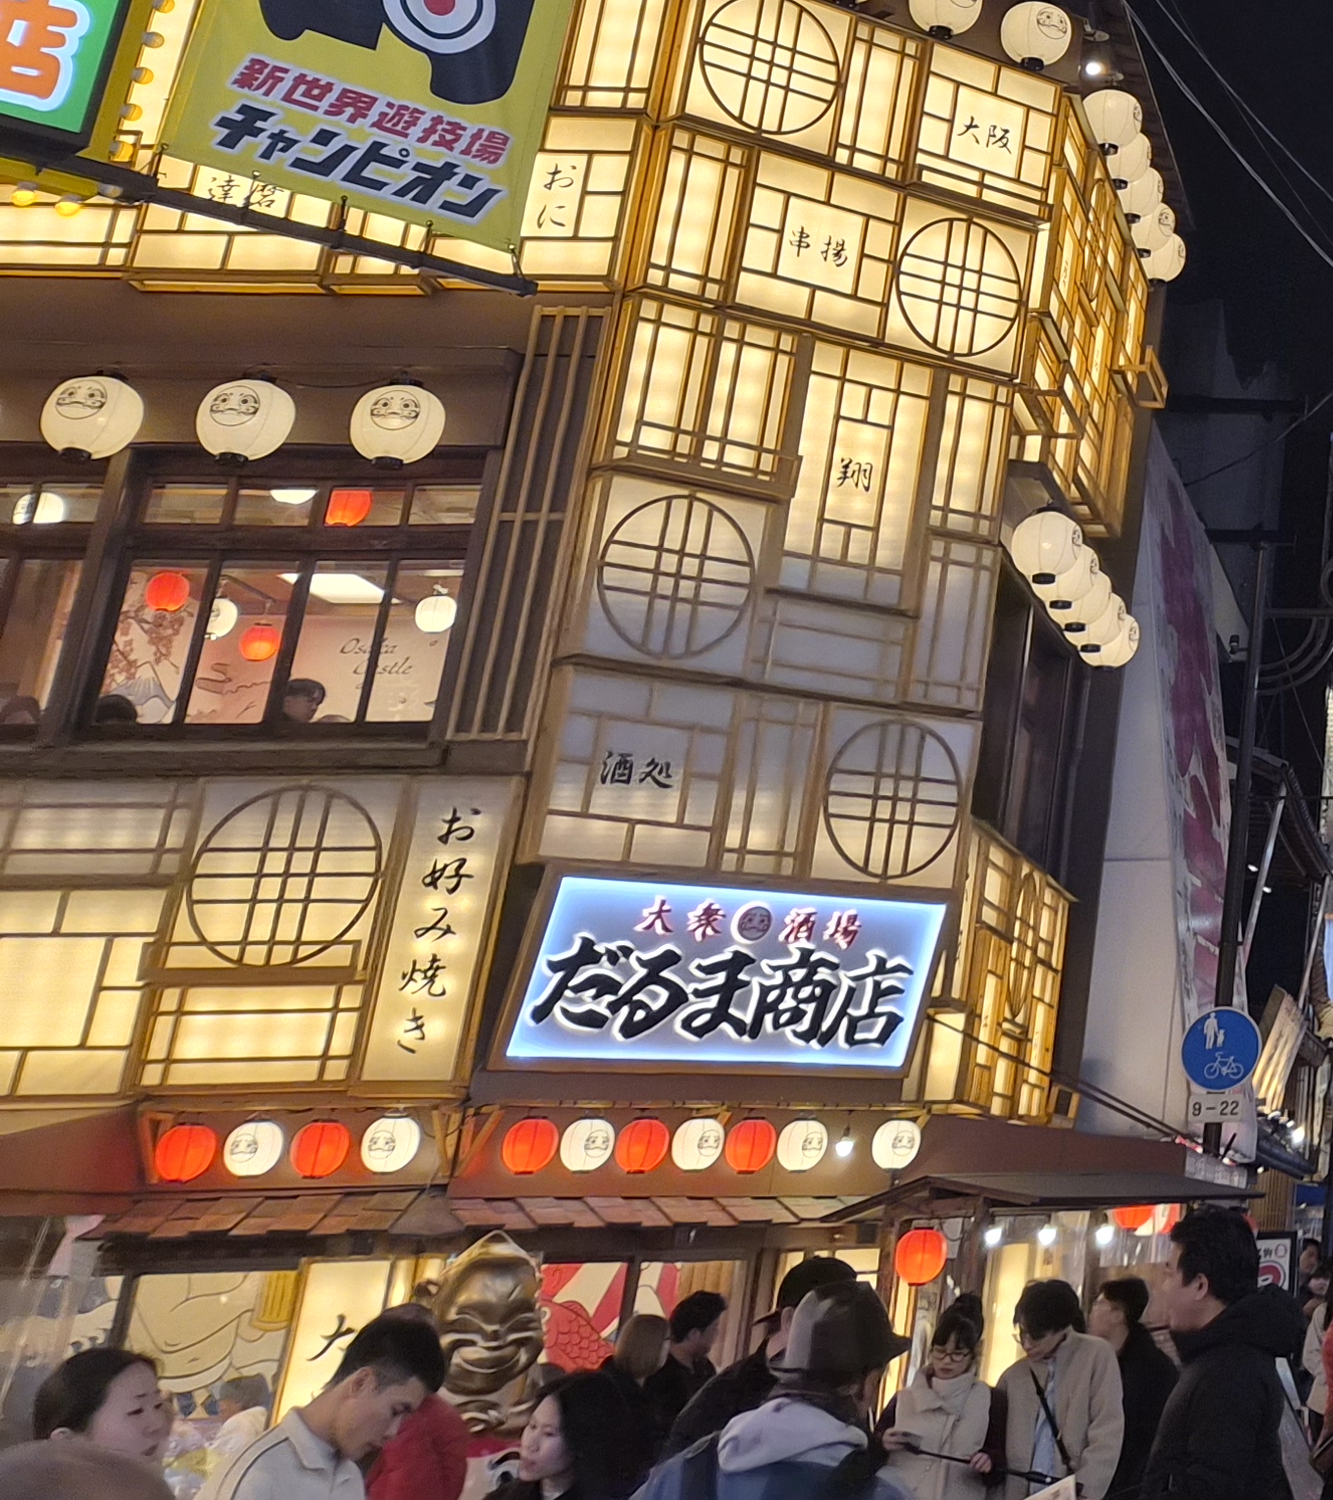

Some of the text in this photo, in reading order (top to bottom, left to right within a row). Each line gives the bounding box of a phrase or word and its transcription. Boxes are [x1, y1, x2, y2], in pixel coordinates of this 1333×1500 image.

[230, 57, 511, 166] 新世界遊技場
[956, 114, 1015, 156] 大阪
[212, 102, 507, 220] チャンピオン
[786, 227, 850, 269] 串揚
[340, 637, 398, 655] Oska
[599, 750, 676, 791] 酒処
[397, 806, 483, 1055] お好み焼き
[531, 932, 916, 1049] だるま商店
[1191, 1101, 1240, 1118] 9-22
